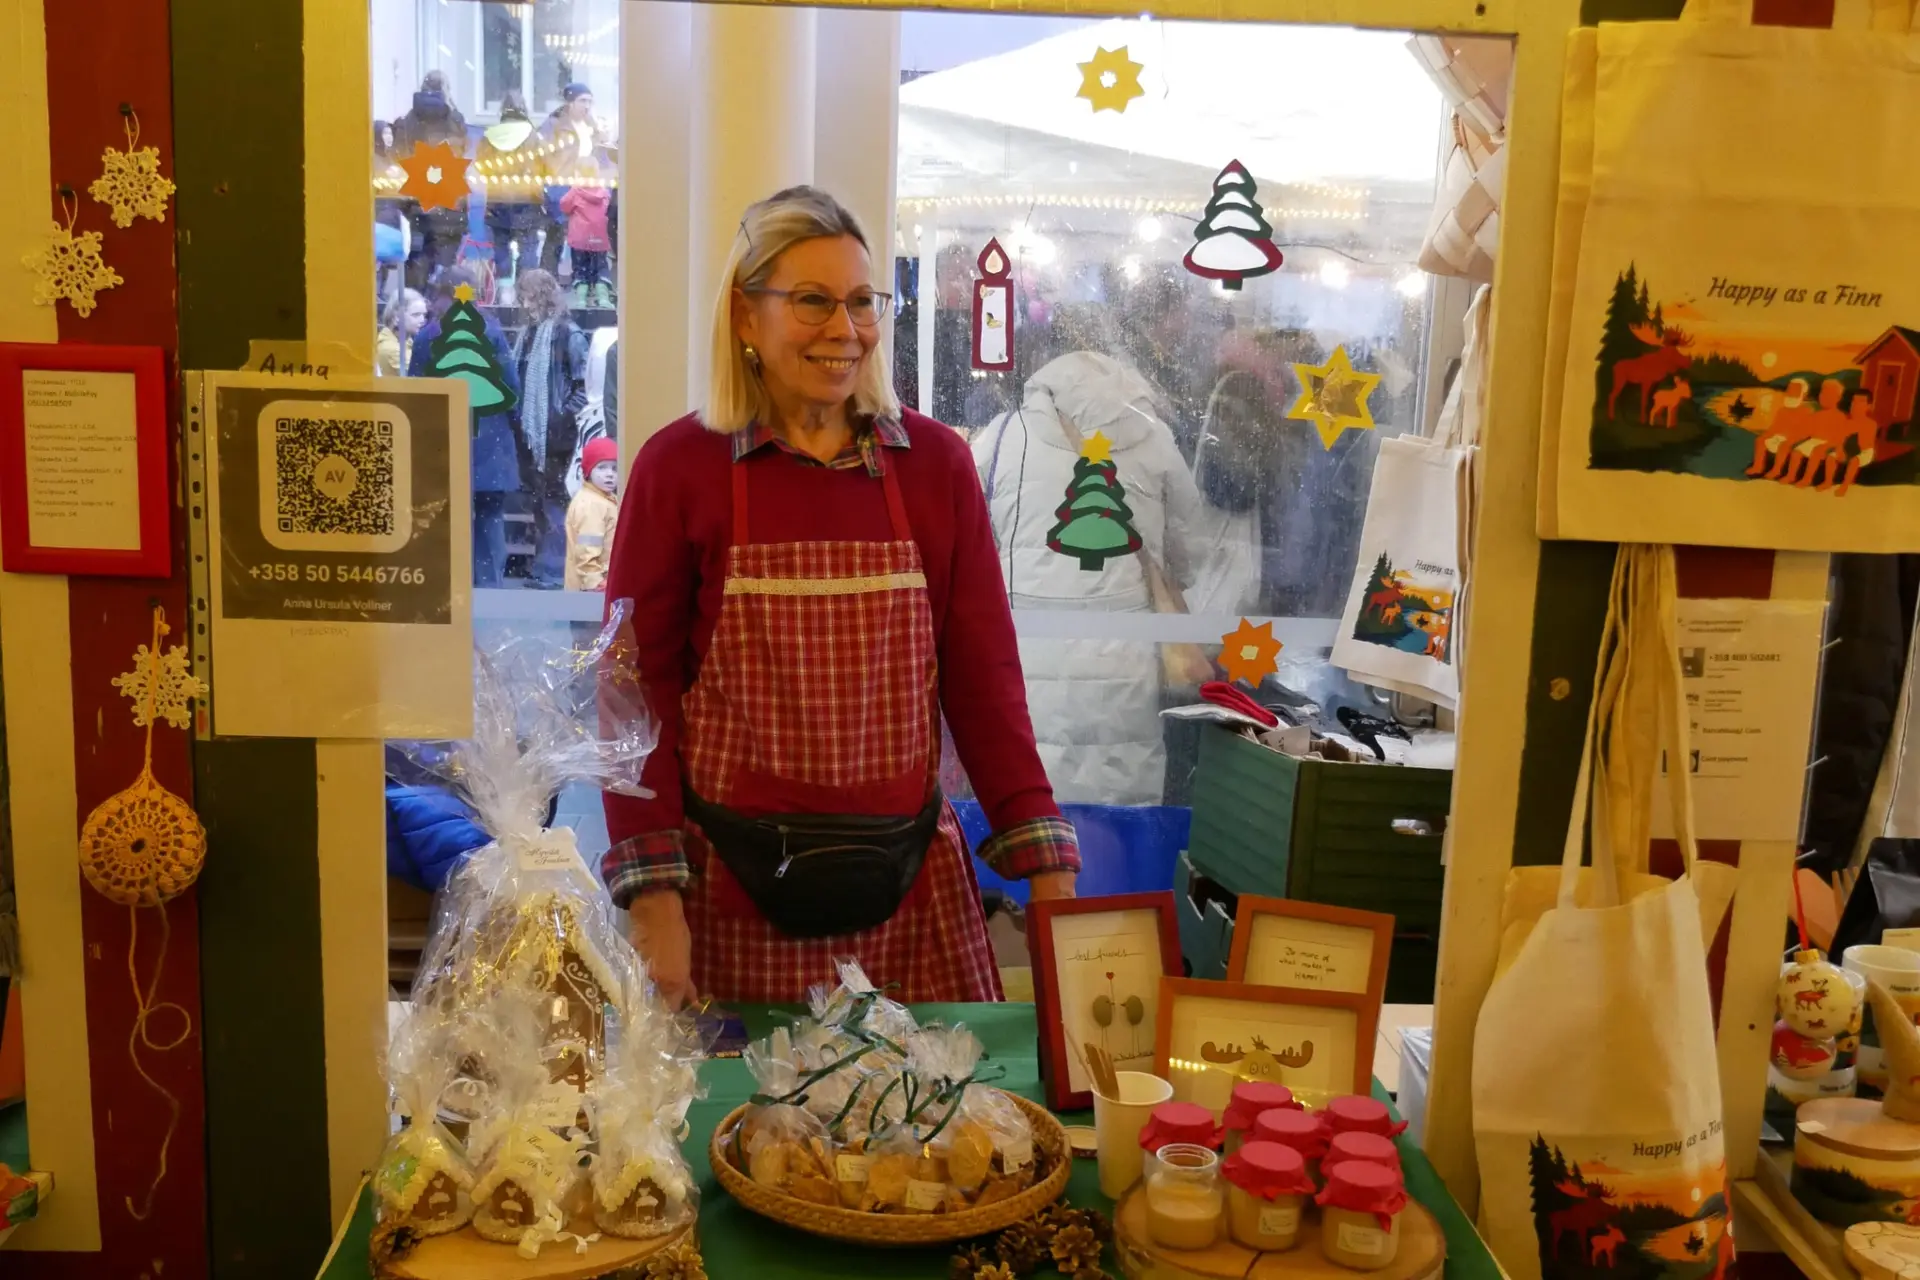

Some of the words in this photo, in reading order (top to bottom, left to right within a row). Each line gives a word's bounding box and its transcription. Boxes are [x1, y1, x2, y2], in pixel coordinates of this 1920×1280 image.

[1707, 277, 1777, 306] Happy
[1784, 289, 1807, 304] as
[1813, 290, 1827, 305] a
[1833, 284, 1882, 307] Finn
[260, 352, 330, 379] Anna
[324, 469, 345, 484] AV
[249, 563, 299, 582] +358
[306, 565, 330, 583] 50
[336, 566, 425, 585] 5446766
[1414, 559, 1442, 576] Happy
[283, 598, 312, 609] Anna
[314, 598, 351, 610] Ursula
[1633, 1140, 1682, 1160] Happy
[1686, 1134, 1697, 1147] as
[1700, 1130, 1707, 1140] a
